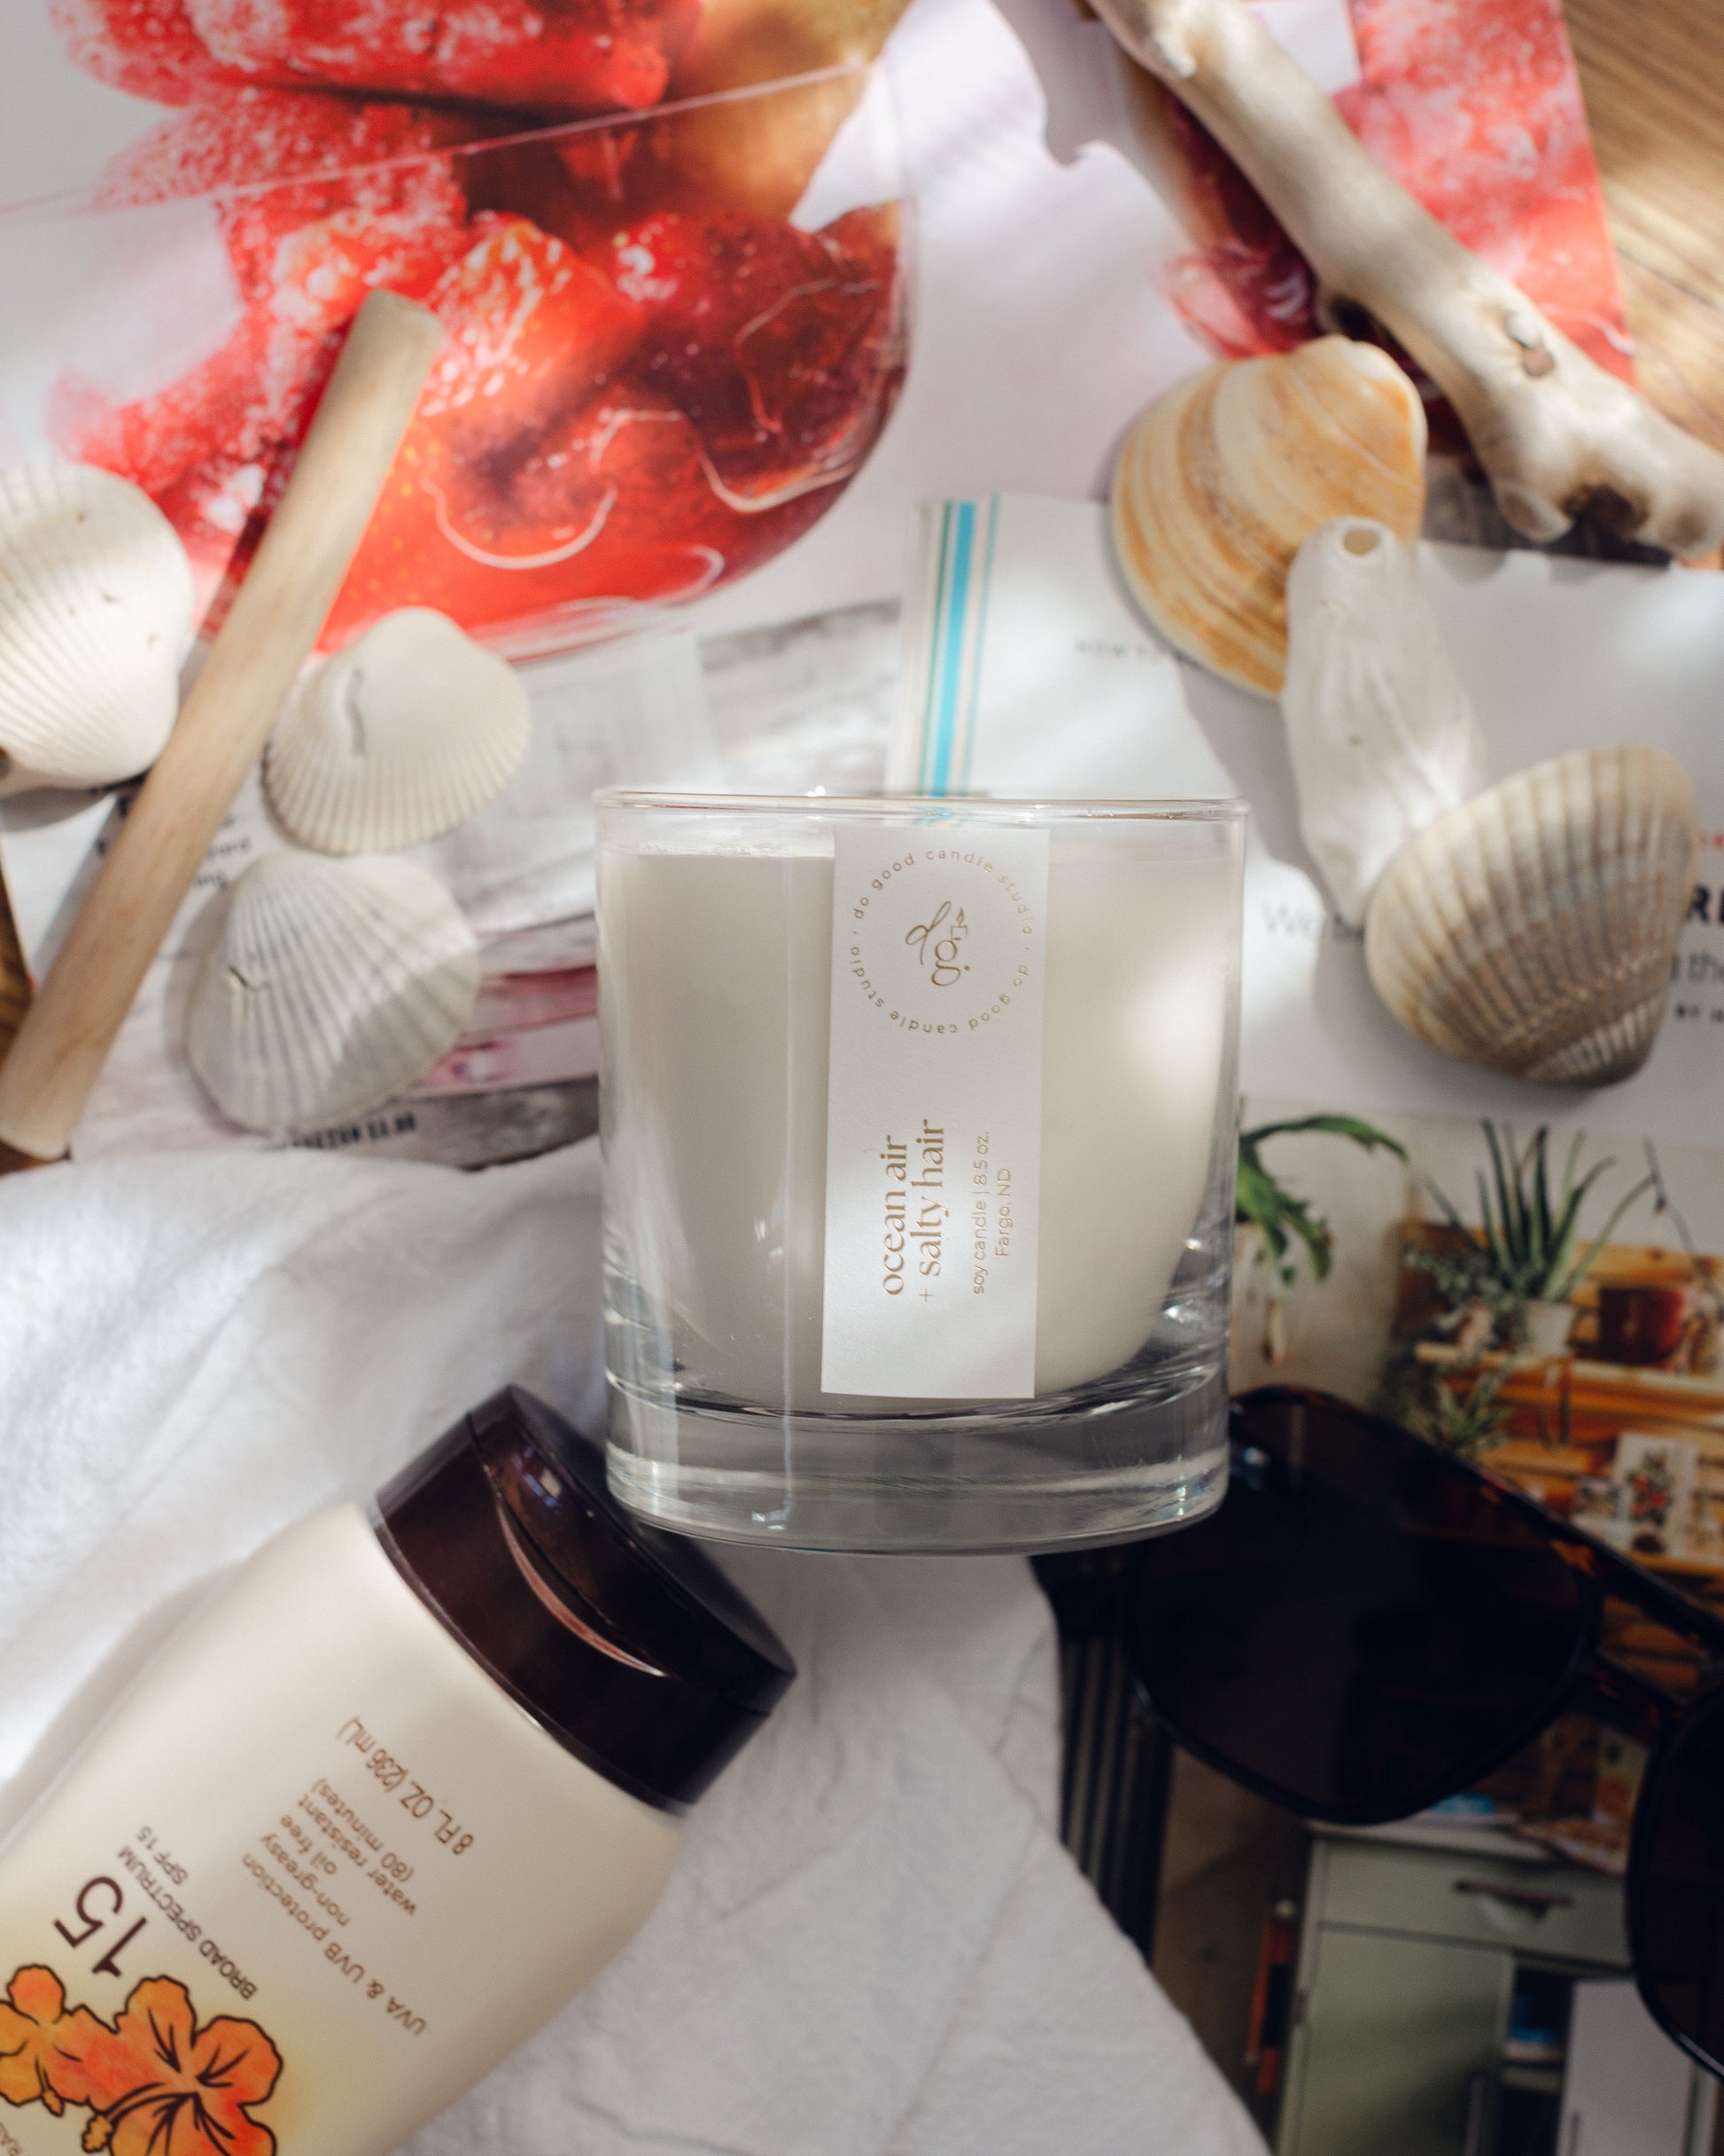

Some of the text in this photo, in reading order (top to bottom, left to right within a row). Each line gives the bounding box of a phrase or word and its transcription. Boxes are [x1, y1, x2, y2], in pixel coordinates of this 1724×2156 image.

[852, 850, 1035, 935] do good candle studio
[850, 946, 1029, 1034] do good candle studio
[910, 1118, 945, 1188] hair
[976, 1131, 990, 1156] oz.
[879, 1134, 908, 1296] ocean air
[909, 1195, 951, 1277] salty
[971, 1200, 988, 1261] candle
[994, 1167, 1013, 1257] Fargo, ND
[973, 1264, 989, 1295] soy
[366, 1748, 408, 1793] (236
[136, 1825, 188, 1886] SPF 15
[280, 1815, 338, 1875] oil free
[298, 1794, 416, 1917] water resistant
[312, 1778, 415, 1883] (80 minutes)
[452, 1834, 474, 1856] 8
[261, 1833, 351, 1926] non-greasy
[53, 1875, 147, 1979] 15
[117, 1846, 258, 2001] BROAD SPECTRUM
[242, 1853, 427, 2035] UVA & UVB protection
